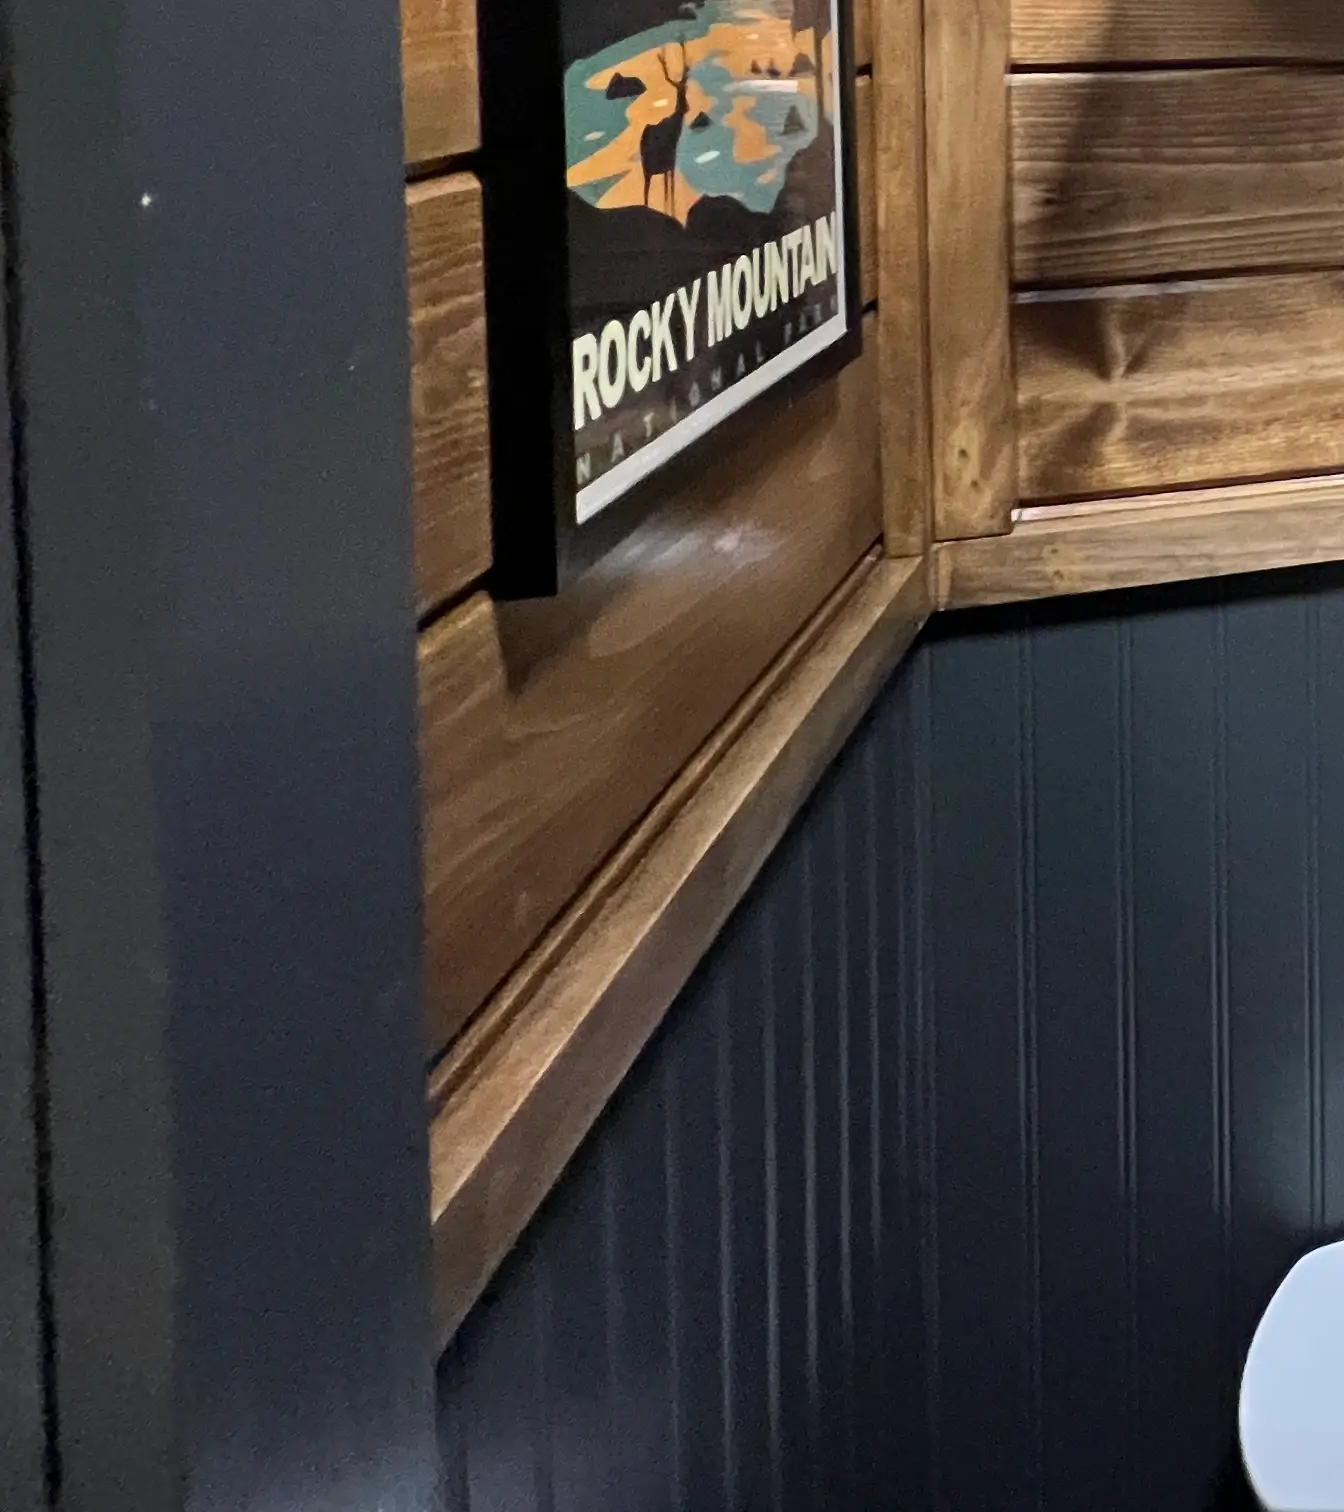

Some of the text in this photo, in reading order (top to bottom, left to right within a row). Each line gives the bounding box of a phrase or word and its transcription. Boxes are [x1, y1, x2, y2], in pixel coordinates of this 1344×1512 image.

[572, 210, 838, 431] ROCKY MOUNTAIN
[575, 340, 764, 485] NATIONAL
